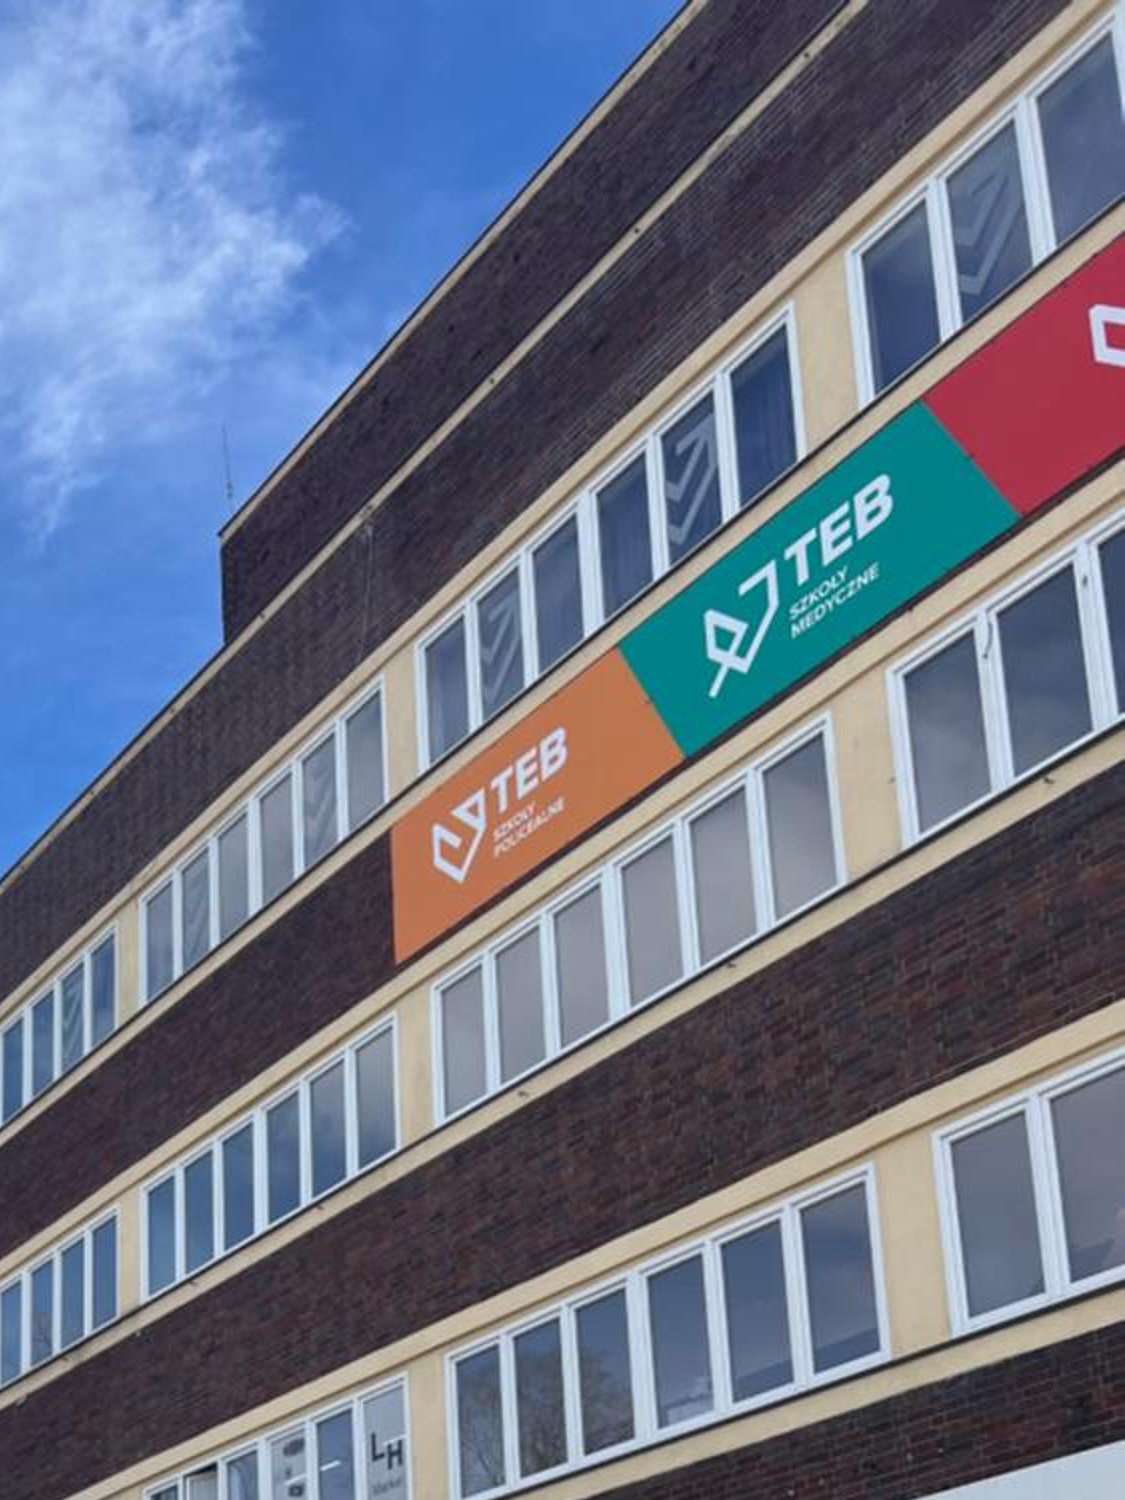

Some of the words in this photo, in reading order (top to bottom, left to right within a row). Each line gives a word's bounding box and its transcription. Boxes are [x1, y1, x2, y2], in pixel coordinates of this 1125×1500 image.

[784, 474, 893, 586] TEB
[790, 561, 879, 639] MEDYCZNE
[491, 727, 568, 814] TEB
